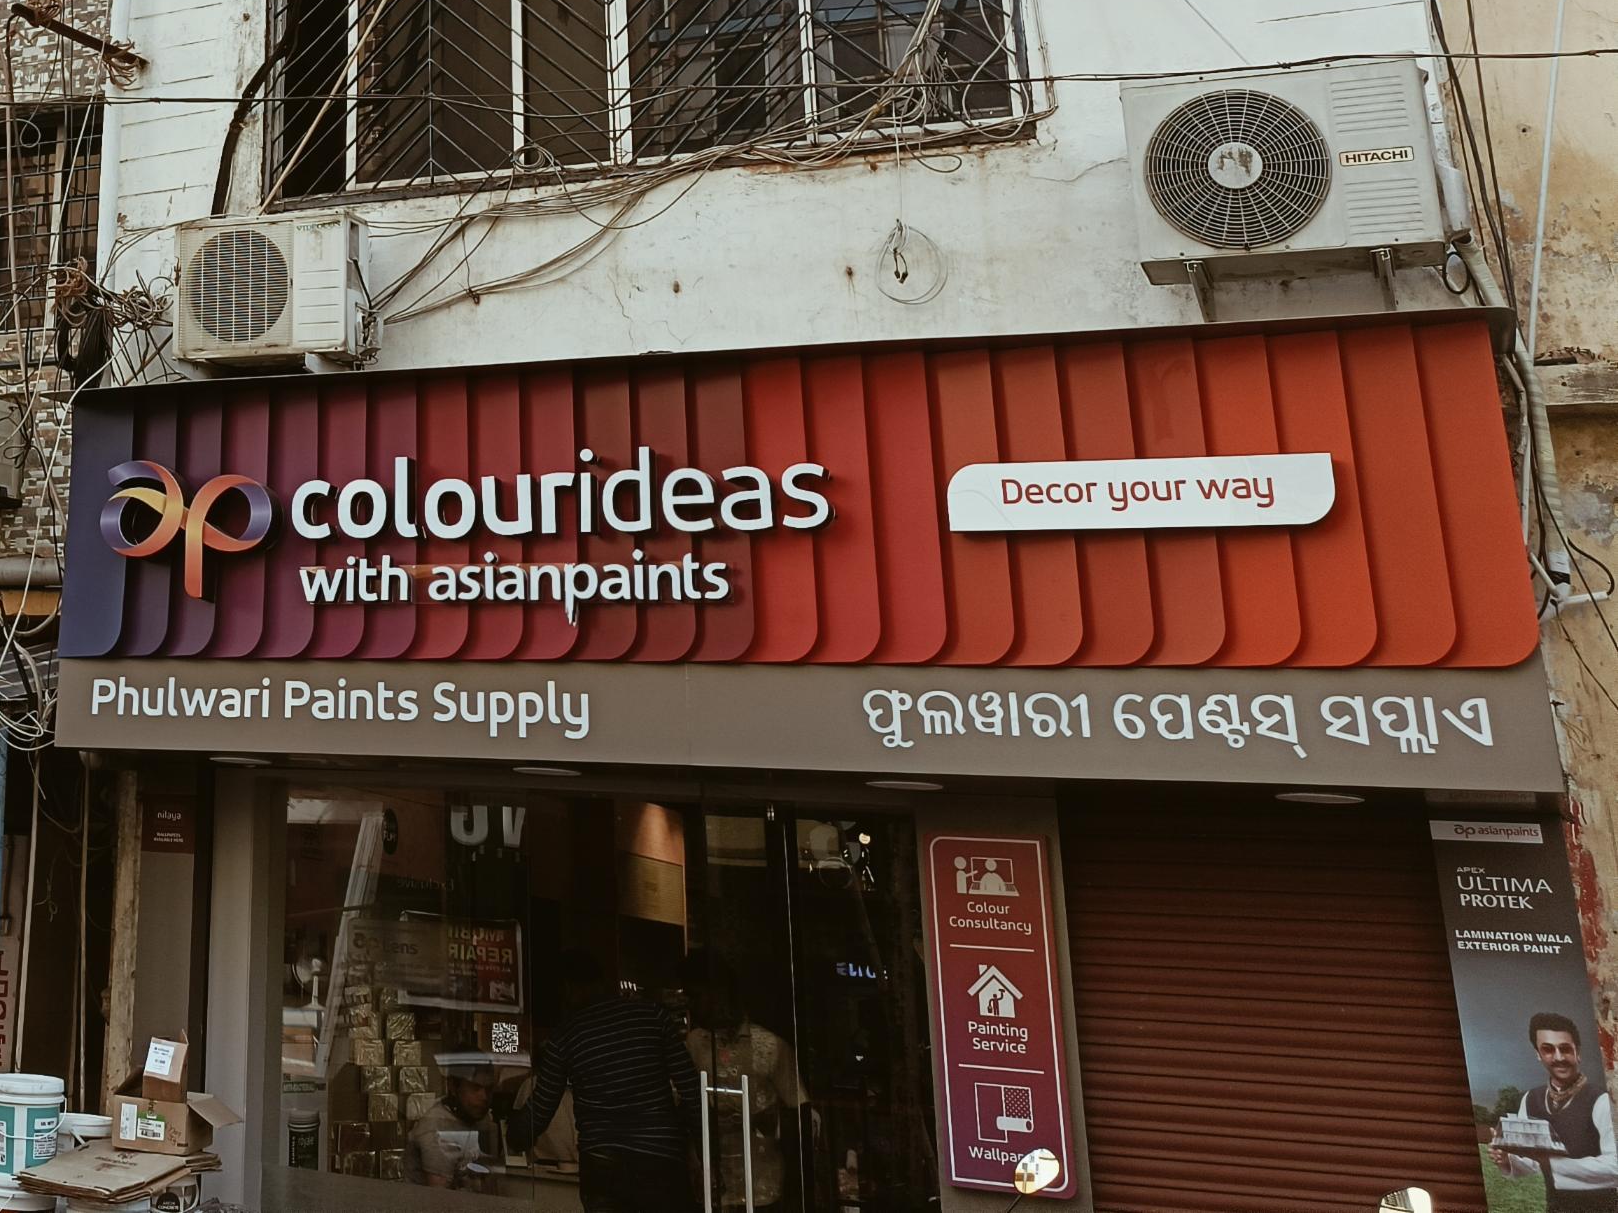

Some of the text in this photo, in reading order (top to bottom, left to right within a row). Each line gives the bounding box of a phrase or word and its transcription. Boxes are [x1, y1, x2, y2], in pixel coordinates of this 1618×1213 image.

[1344, 148, 1409, 165] HITACHI
[291, 446, 833, 540] colourideas
[1001, 475, 1275, 512] Decor your way
[300, 550, 730, 626] with asianpaints
[91, 676, 589, 738] Phulwari Paints Supply
[1478, 826, 1539, 839] asianpaints
[1456, 866, 1485, 874] APEX
[1457, 876, 1553, 894] ULTIMA
[966, 901, 1011, 915] Colour
[1459, 893, 1534, 910] PROTEK
[949, 916, 1032, 935] Consultancy
[1455, 930, 1573, 944] LAMINATION WALA
[1457, 941, 1561, 954] EXTERIOR PAINT
[968, 1021, 1028, 1041] Painting
[972, 1038, 1026, 1054] Service
